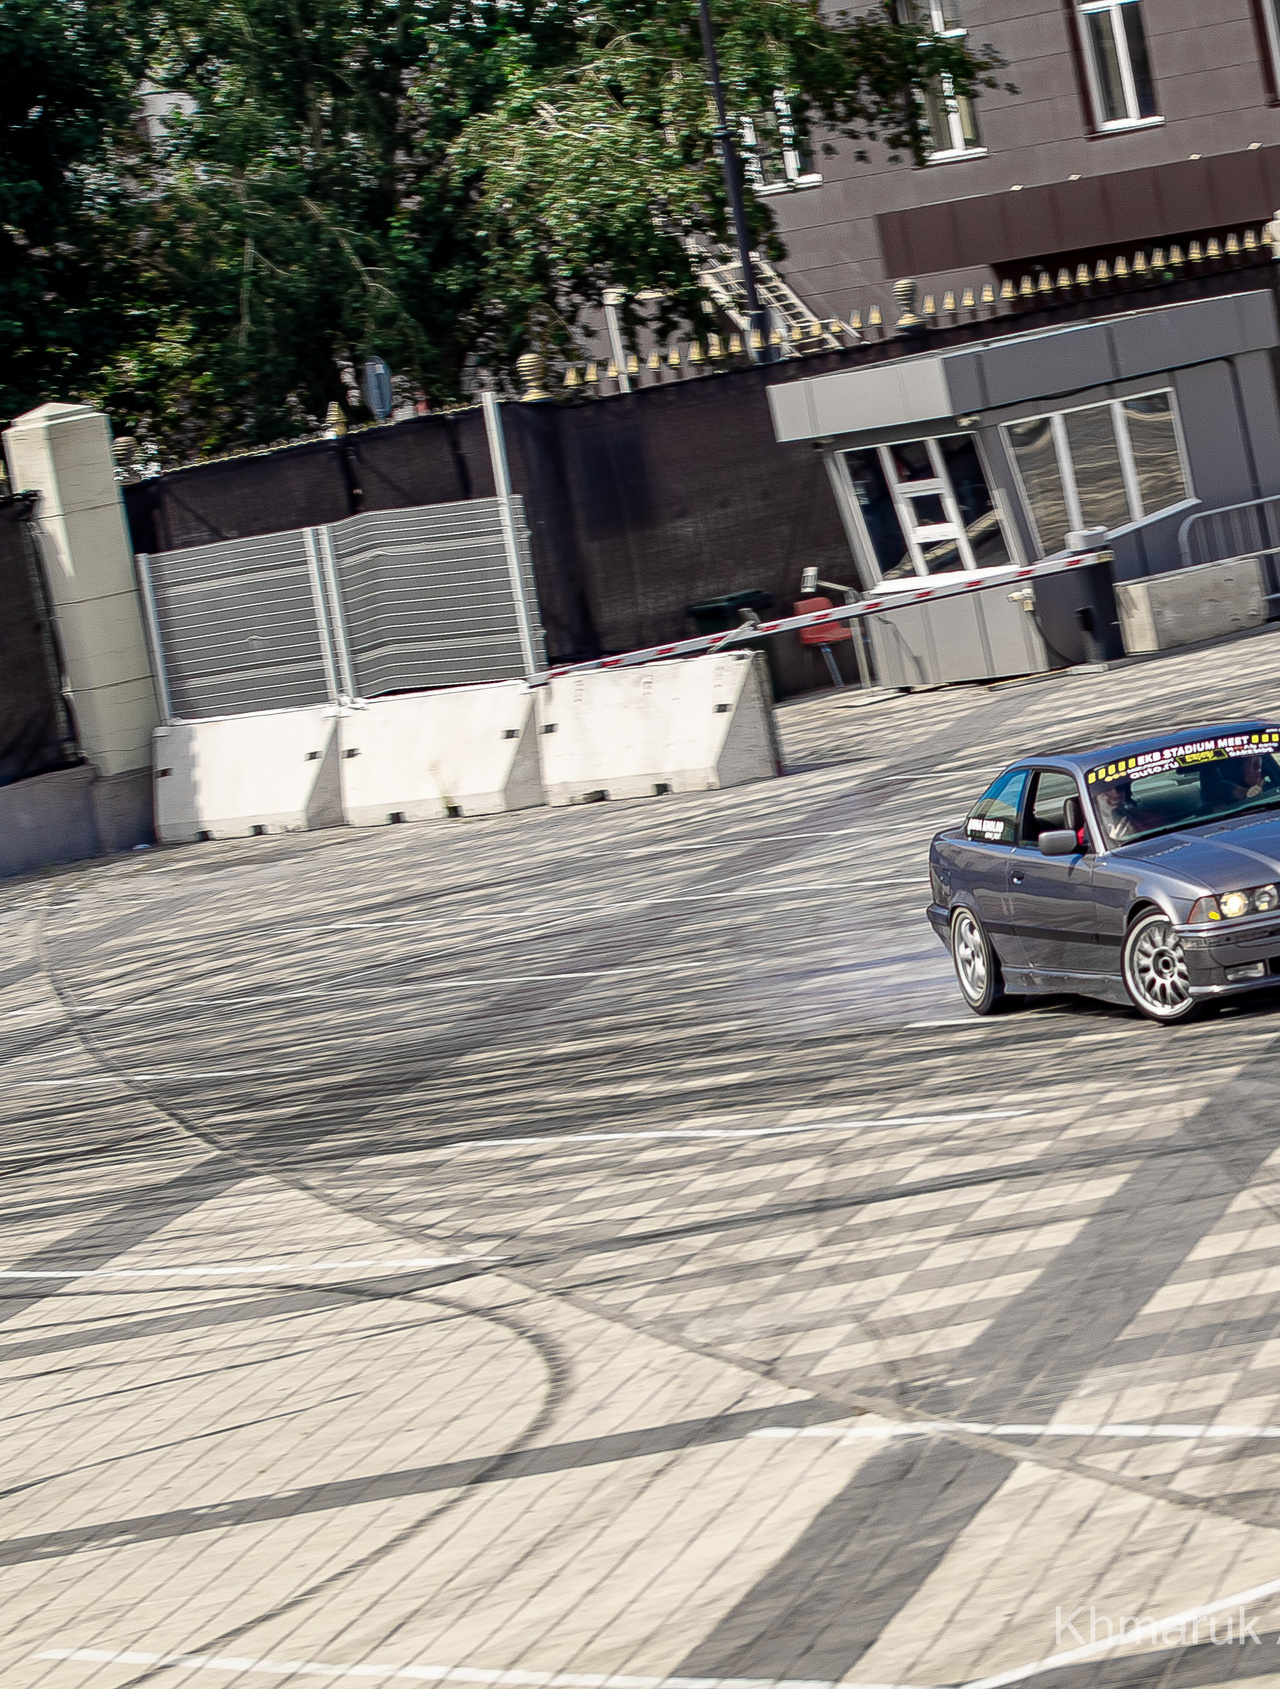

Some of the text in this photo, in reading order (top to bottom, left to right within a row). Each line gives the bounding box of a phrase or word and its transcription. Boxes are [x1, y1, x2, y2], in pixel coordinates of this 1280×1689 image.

[1136, 751, 1162, 766] EKB
[1162, 740, 1216, 759] STADIUM
[1217, 735, 1250, 749] MEET
[1129, 761, 1180, 780] auto.ru
